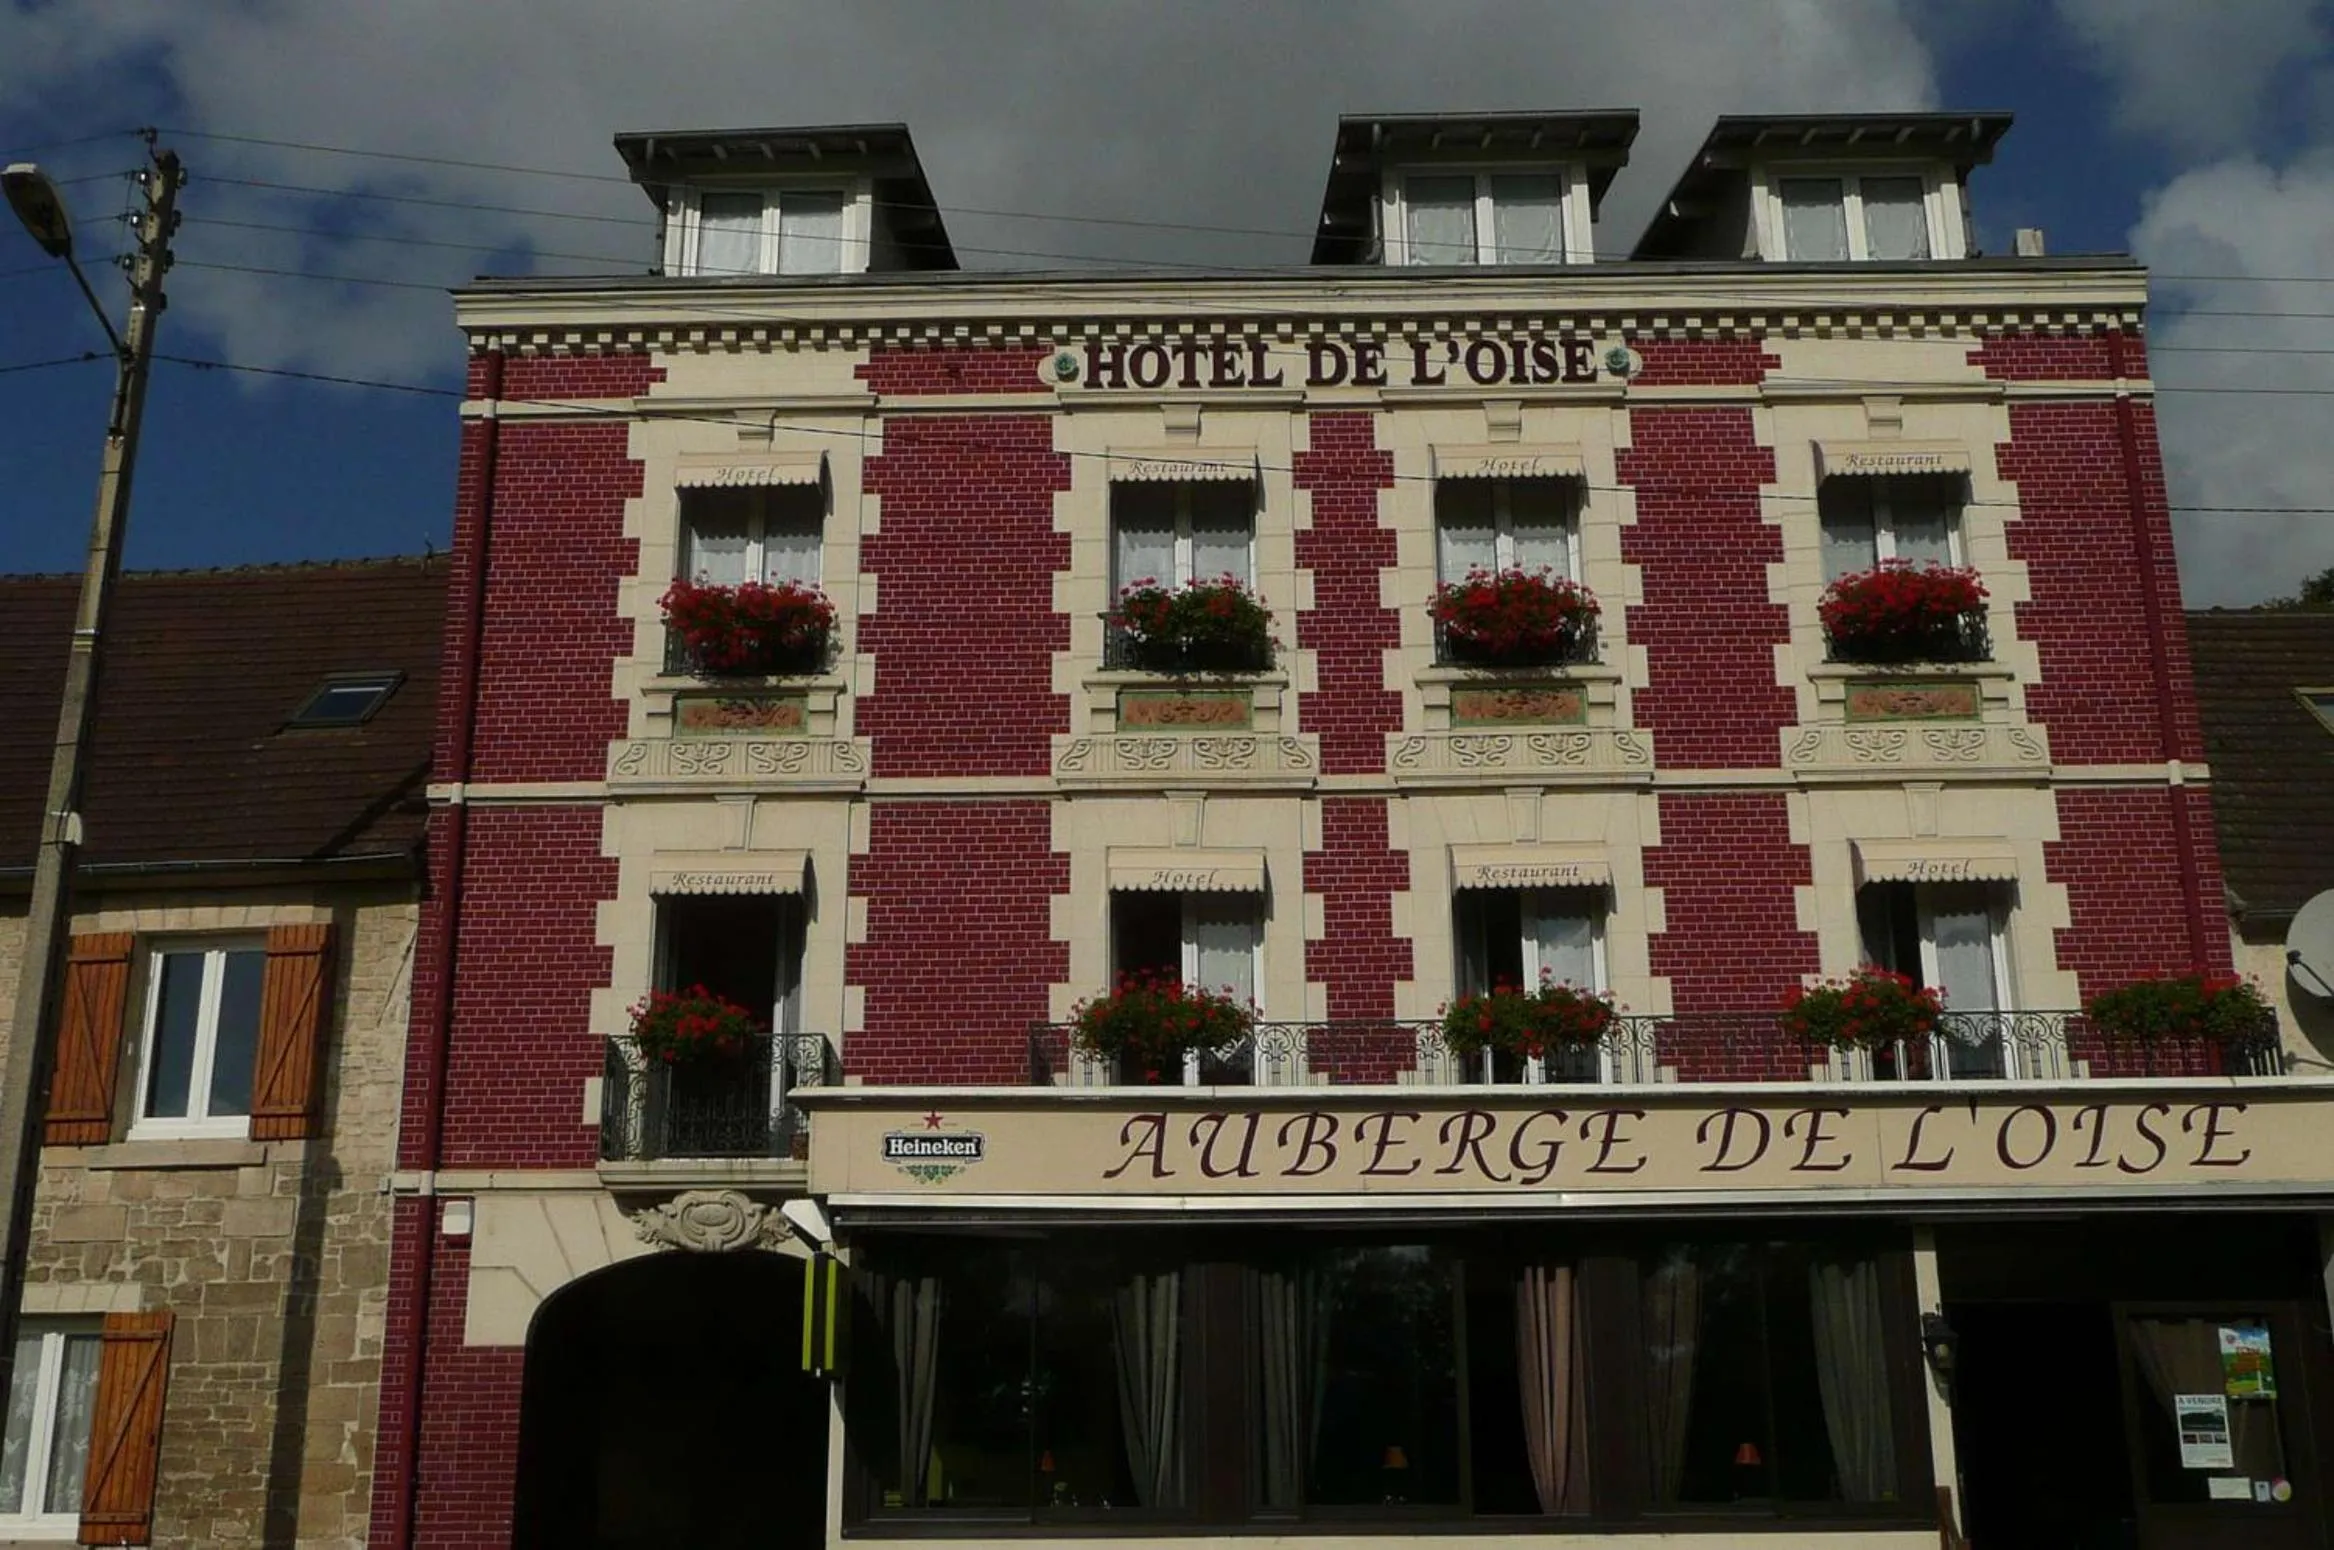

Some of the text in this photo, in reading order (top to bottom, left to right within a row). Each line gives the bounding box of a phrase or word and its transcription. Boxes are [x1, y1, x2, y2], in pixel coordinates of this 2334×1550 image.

[1083, 338, 1597, 388] HOTEL DE L'OISE
[1480, 456, 1541, 471] Hotel
[1846, 453, 1943, 467] Restaurant
[717, 464, 777, 480] Hotel
[1130, 462, 1226, 476] Restaurant
[1476, 864, 1579, 880] Restaurant
[1907, 858, 1971, 875] Hotel
[672, 872, 774, 887] Restaurant
[1152, 868, 1219, 885] Hotel
[889, 1138, 977, 1155] Heineken
[1102, 1097, 2251, 1185] AUBERGE DE L'OISE
